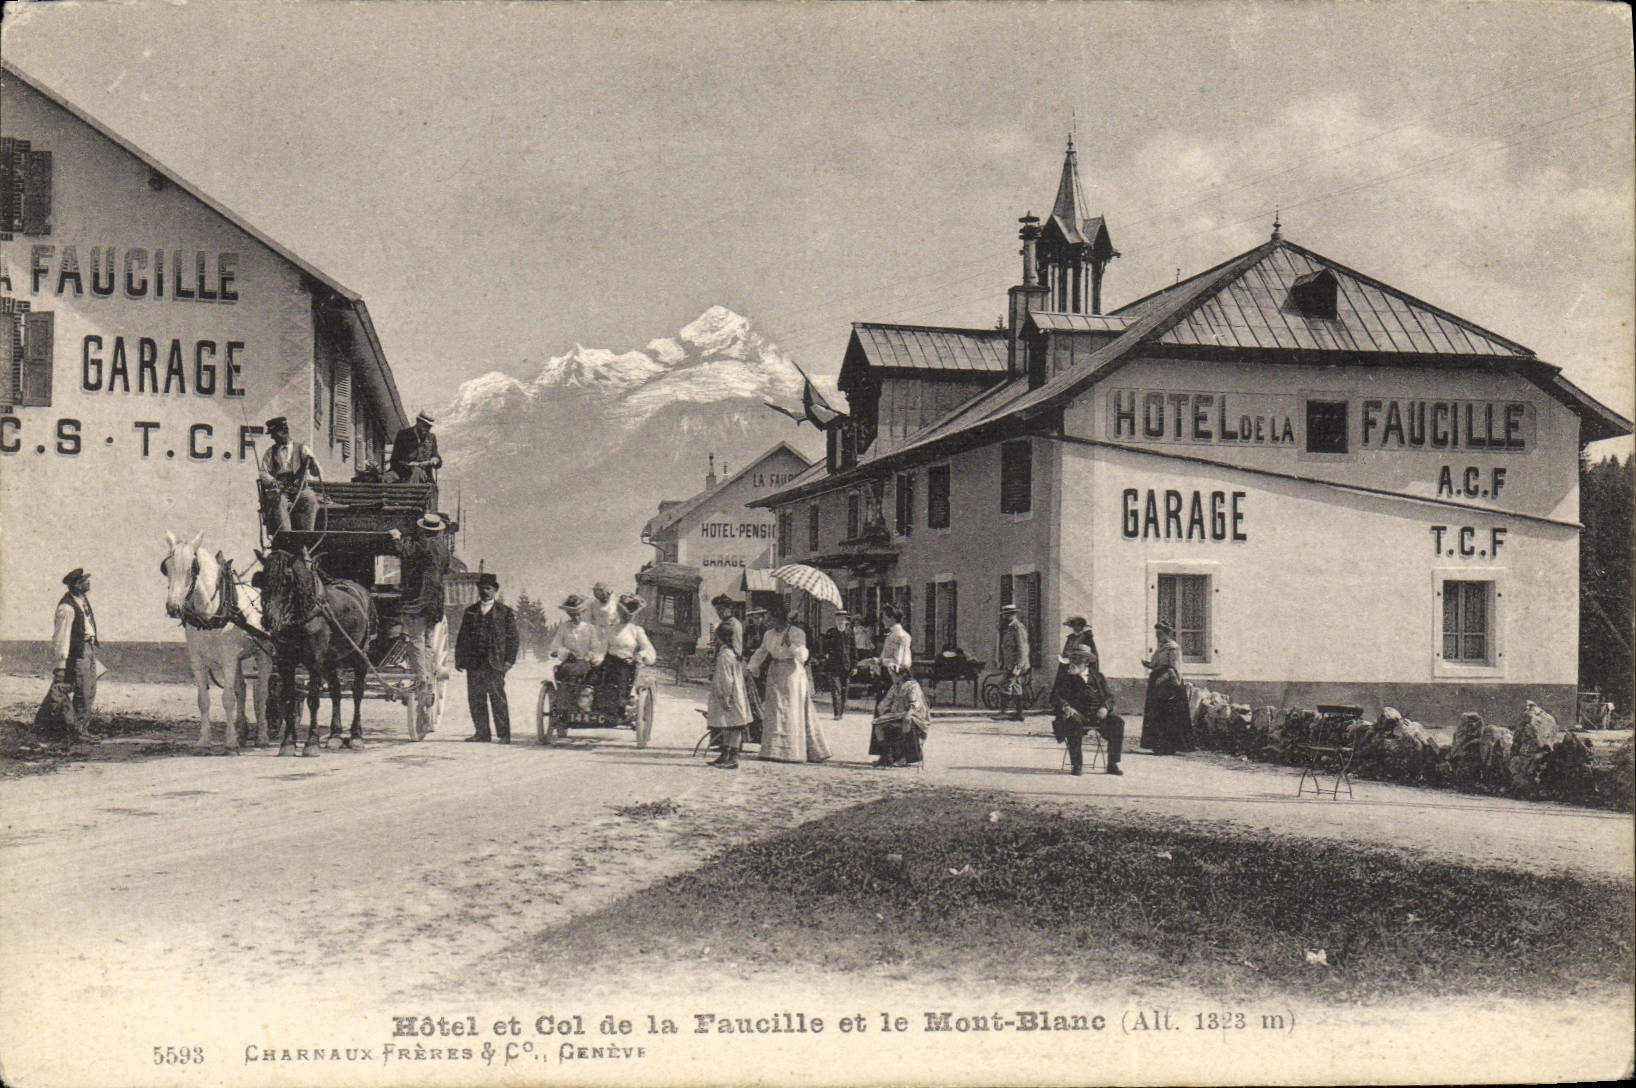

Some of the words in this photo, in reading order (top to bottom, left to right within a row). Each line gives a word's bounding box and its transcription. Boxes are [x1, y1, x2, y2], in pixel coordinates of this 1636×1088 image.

[31, 245, 239, 304] FAUCILLE
[82, 335, 246, 397] GARAGE
[1114, 390, 1238, 441] HOTEL
[1361, 400, 1526, 450] FAUCILLE
[753, 473, 765, 487] LA
[1437, 465, 1507, 498] A.C.F
[1122, 488, 1248, 542] GARAGE
[1430, 525, 1508, 557] T.C.F
